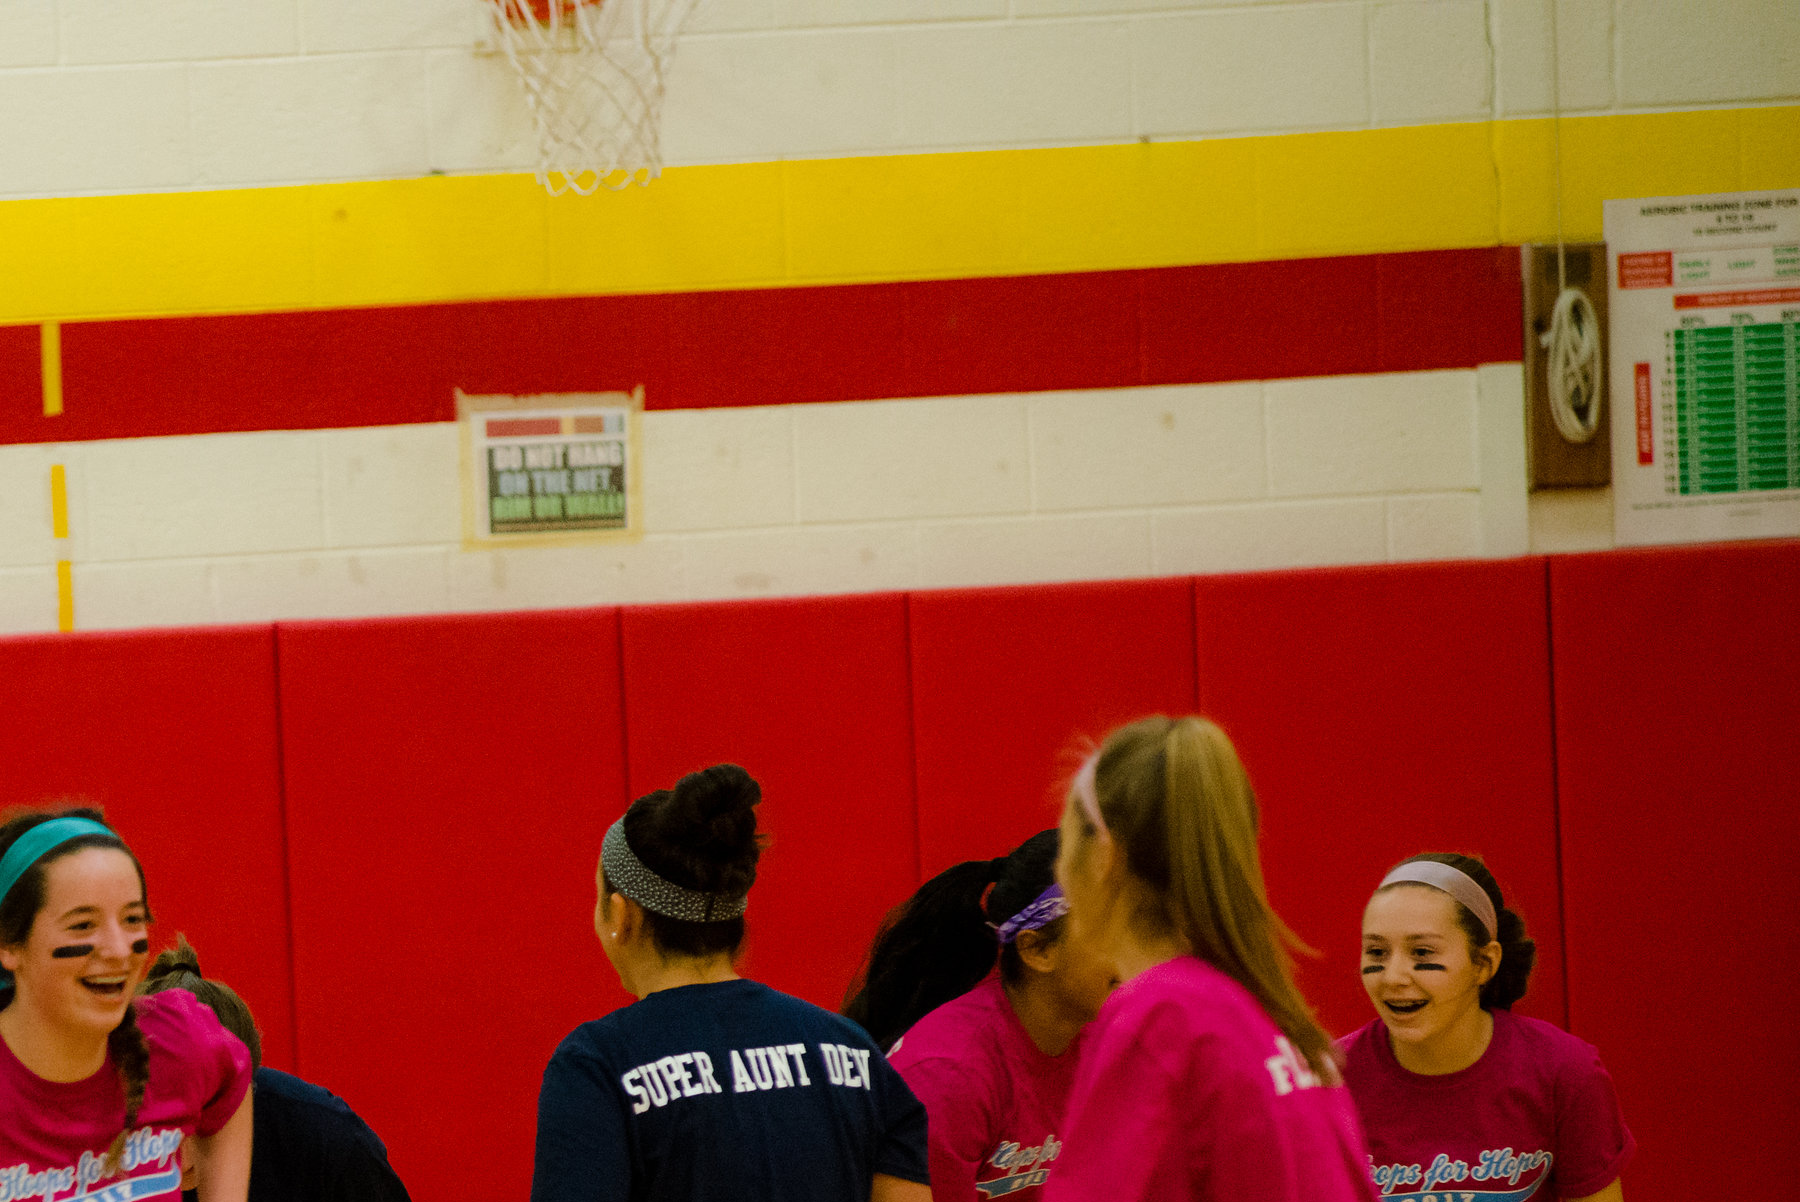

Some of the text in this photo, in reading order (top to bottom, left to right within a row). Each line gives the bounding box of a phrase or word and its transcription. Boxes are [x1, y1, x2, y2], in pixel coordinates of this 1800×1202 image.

[525, 443, 563, 469] NOT
[567, 441, 622, 467] HANG
[621, 1051, 722, 1115] SUPER
[730, 1043, 811, 1093] AUNT
[1421, 1153, 1469, 1191] for
[1471, 1147, 1545, 1186] Hope
